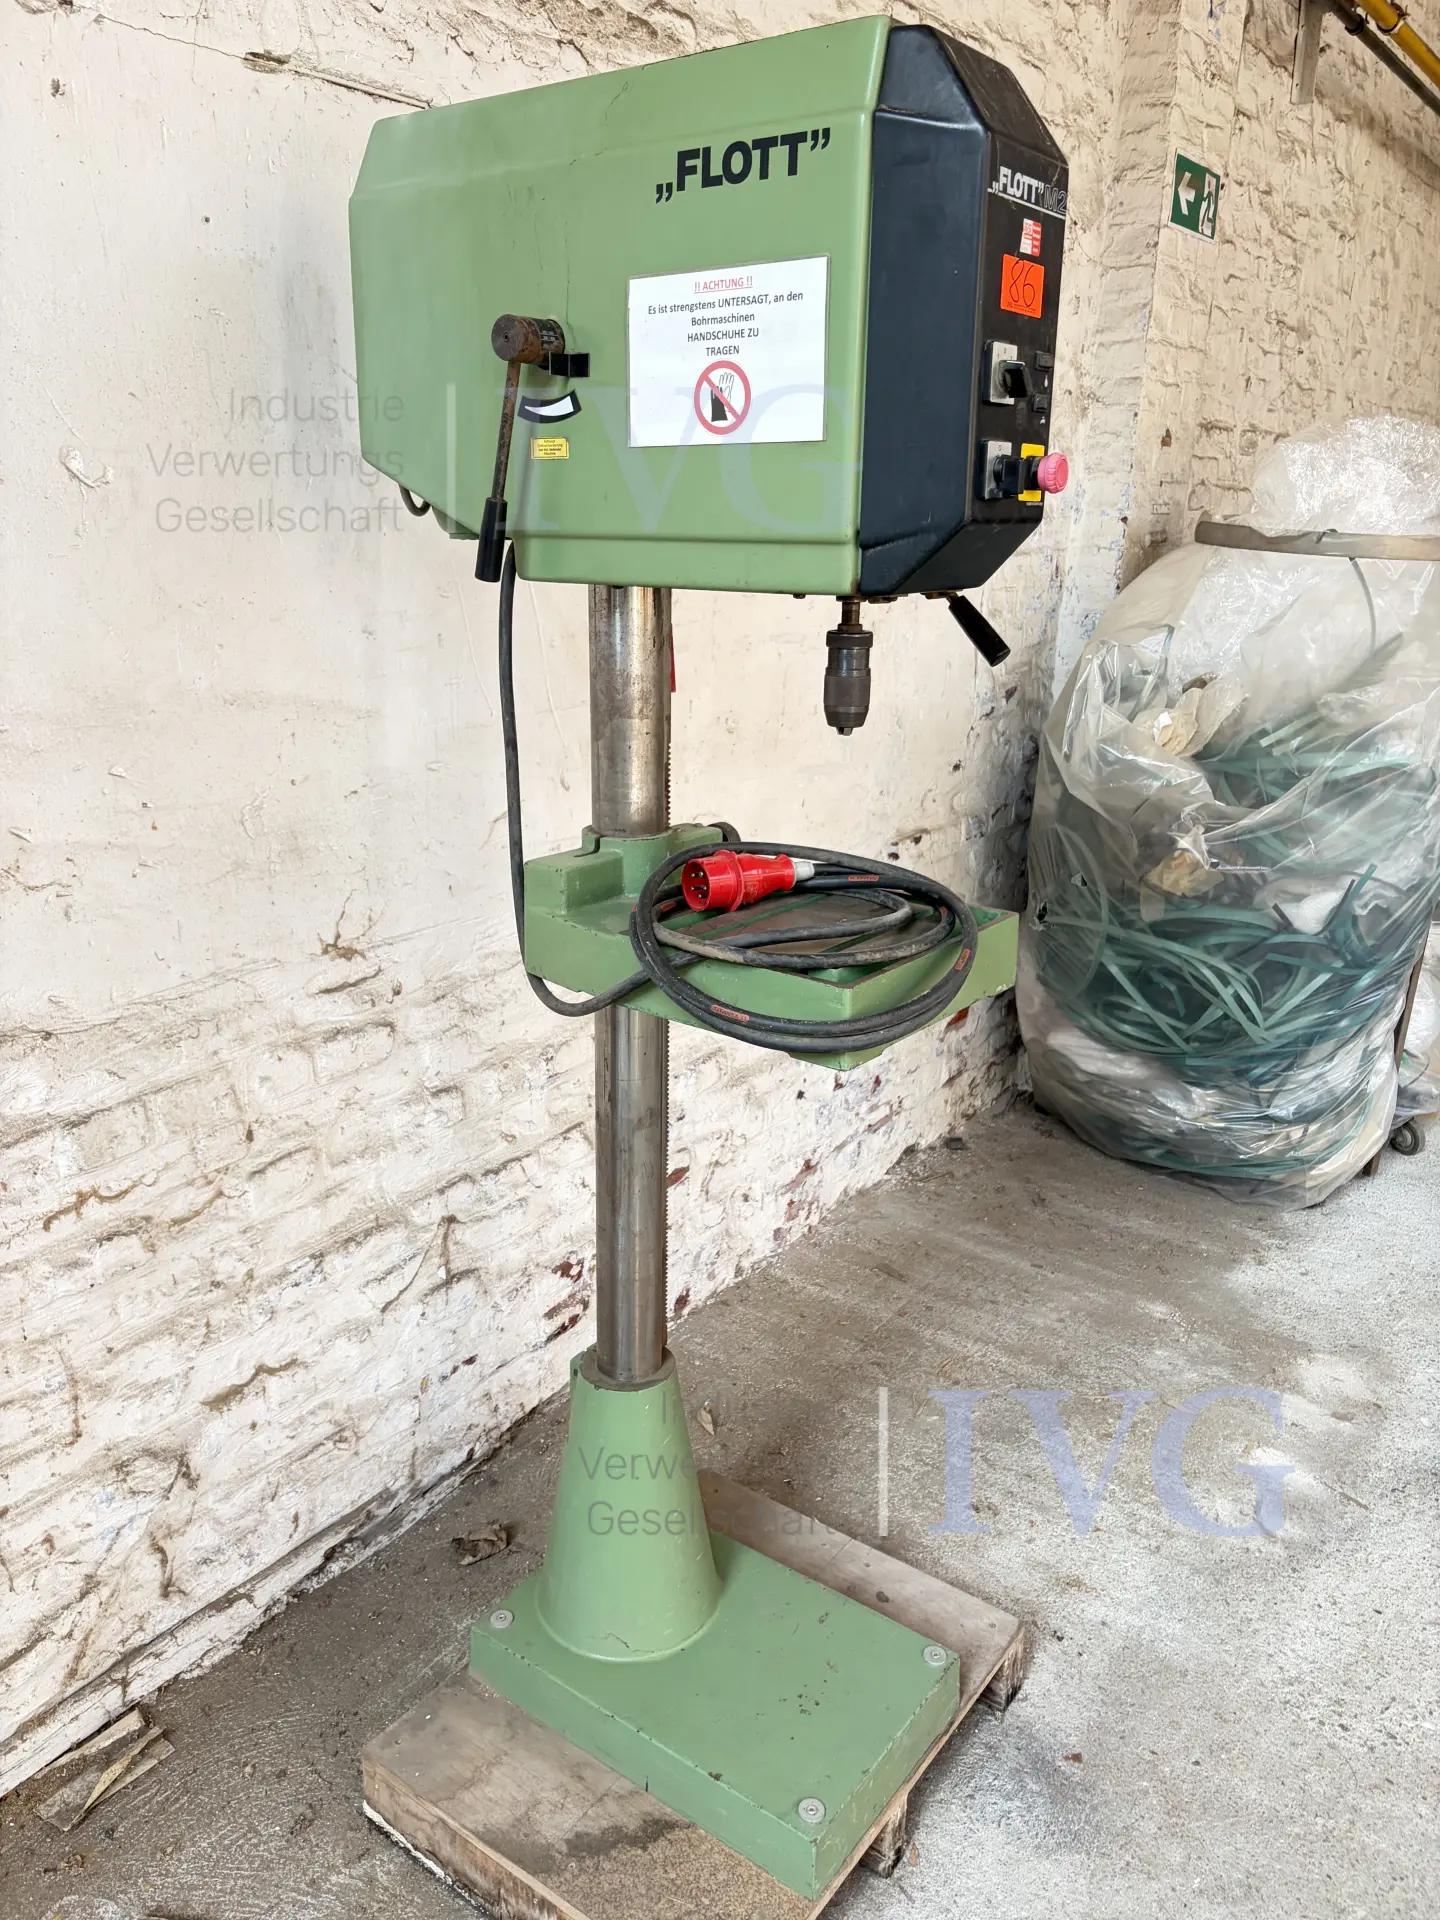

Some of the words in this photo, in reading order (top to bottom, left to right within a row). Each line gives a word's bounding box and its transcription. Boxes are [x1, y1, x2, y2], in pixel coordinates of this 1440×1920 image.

[702, 277, 744, 292] ACHTUNG
[1009, 259, 1036, 307] 86
[648, 305, 657, 315] Es
[658, 302, 668, 314] ist
[669, 300, 716, 314] strengstens
[718, 293, 772, 309] UNTERSAGT,
[773, 295, 785, 303] an
[786, 291, 804, 302] den
[691, 312, 755, 327] Bohrmaschinen
[687, 328, 746, 343] HANDSCHUHE
[747, 327, 760, 338] ZU
[705, 345, 740, 357] TRAGEN
